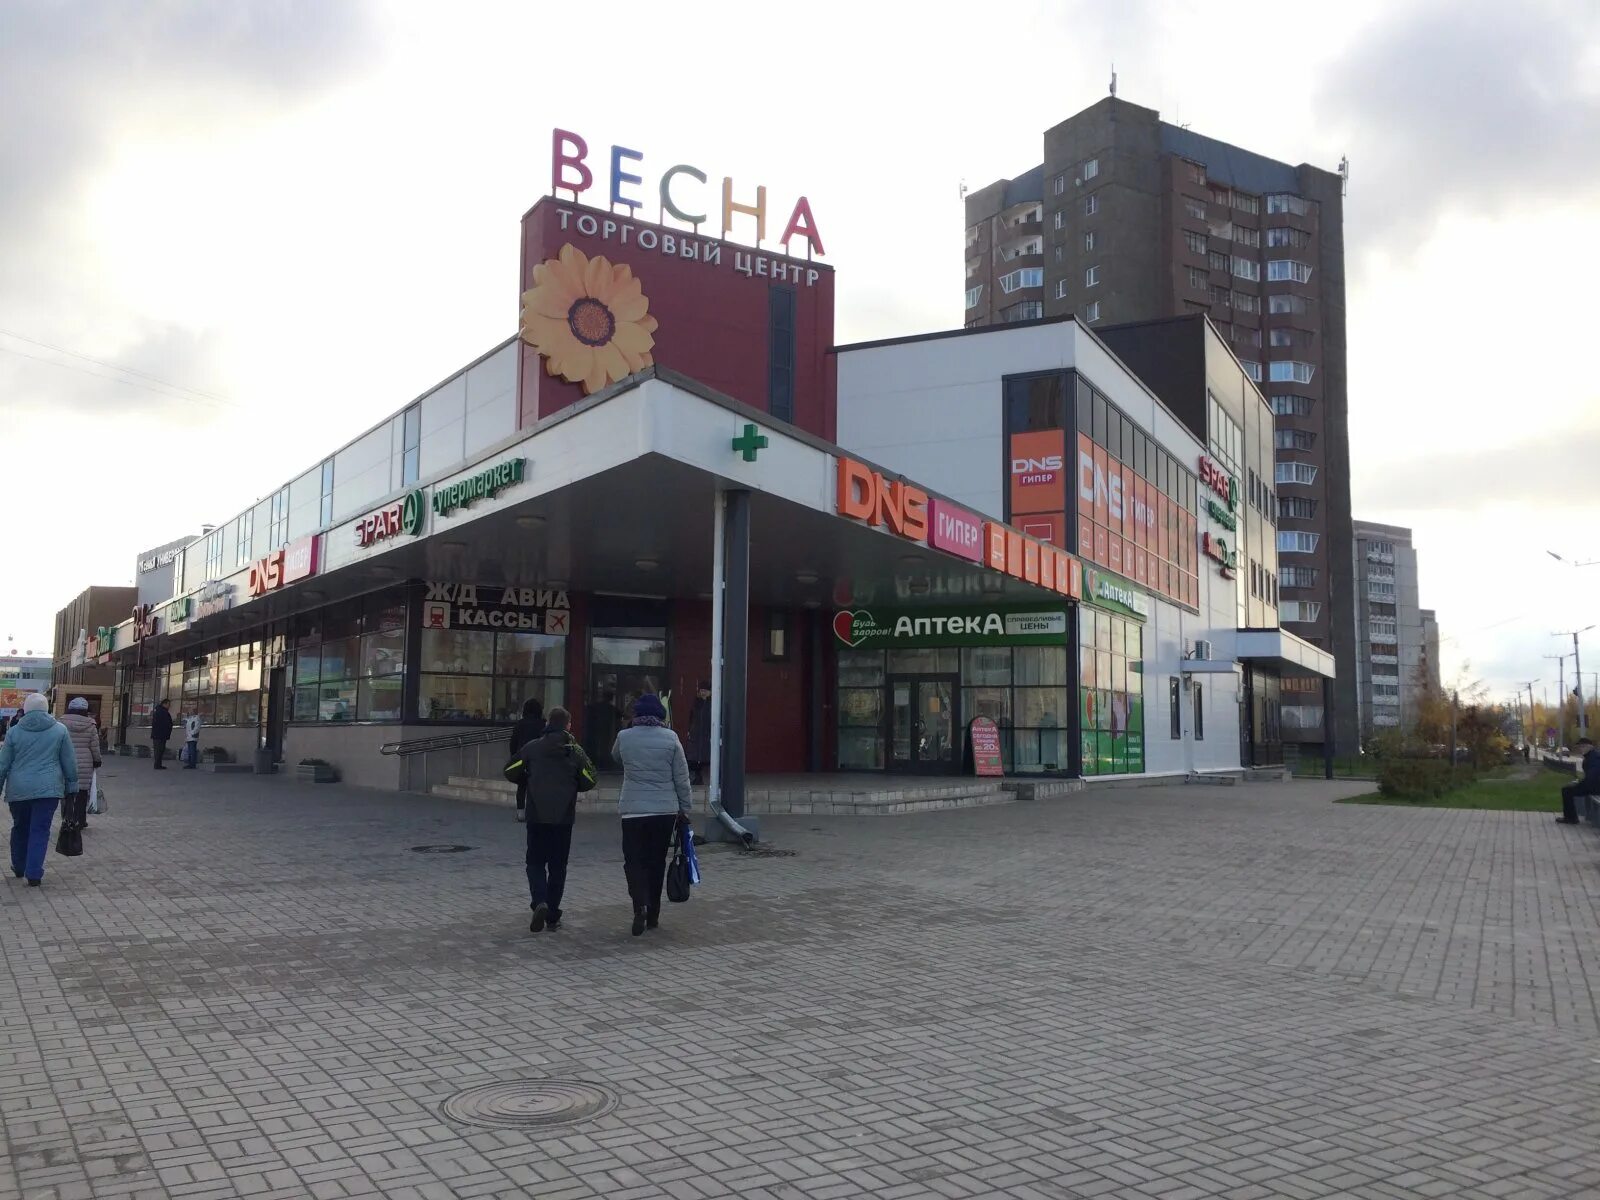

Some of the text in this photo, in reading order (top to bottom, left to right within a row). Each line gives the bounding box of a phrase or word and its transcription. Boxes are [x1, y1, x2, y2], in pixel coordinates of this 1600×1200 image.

[552, 127, 826, 256] ВЕСНА
[556, 208, 820, 287] ТОРГОВЫЙ ЦЕНТР
[1012, 455, 1063, 474] DNS
[1022, 473, 1053, 484] ГИПЕР
[1199, 454, 1230, 504] SPAR
[432, 457, 526, 517] супермаркет
[837, 456, 929, 541] DNS
[1080, 450, 1127, 522] DNS
[355, 503, 403, 549] SPAR
[938, 511, 978, 548] ГИПЕР
[248, 550, 285, 597] DNS
[425, 581, 571, 609] Ж/Д АВИА
[458, 608, 538, 629] КАССЫ
[852, 619, 877, 629] Будь
[894, 613, 1005, 637] АптекА
[1020, 622, 1049, 630] ЦЕНЫ
